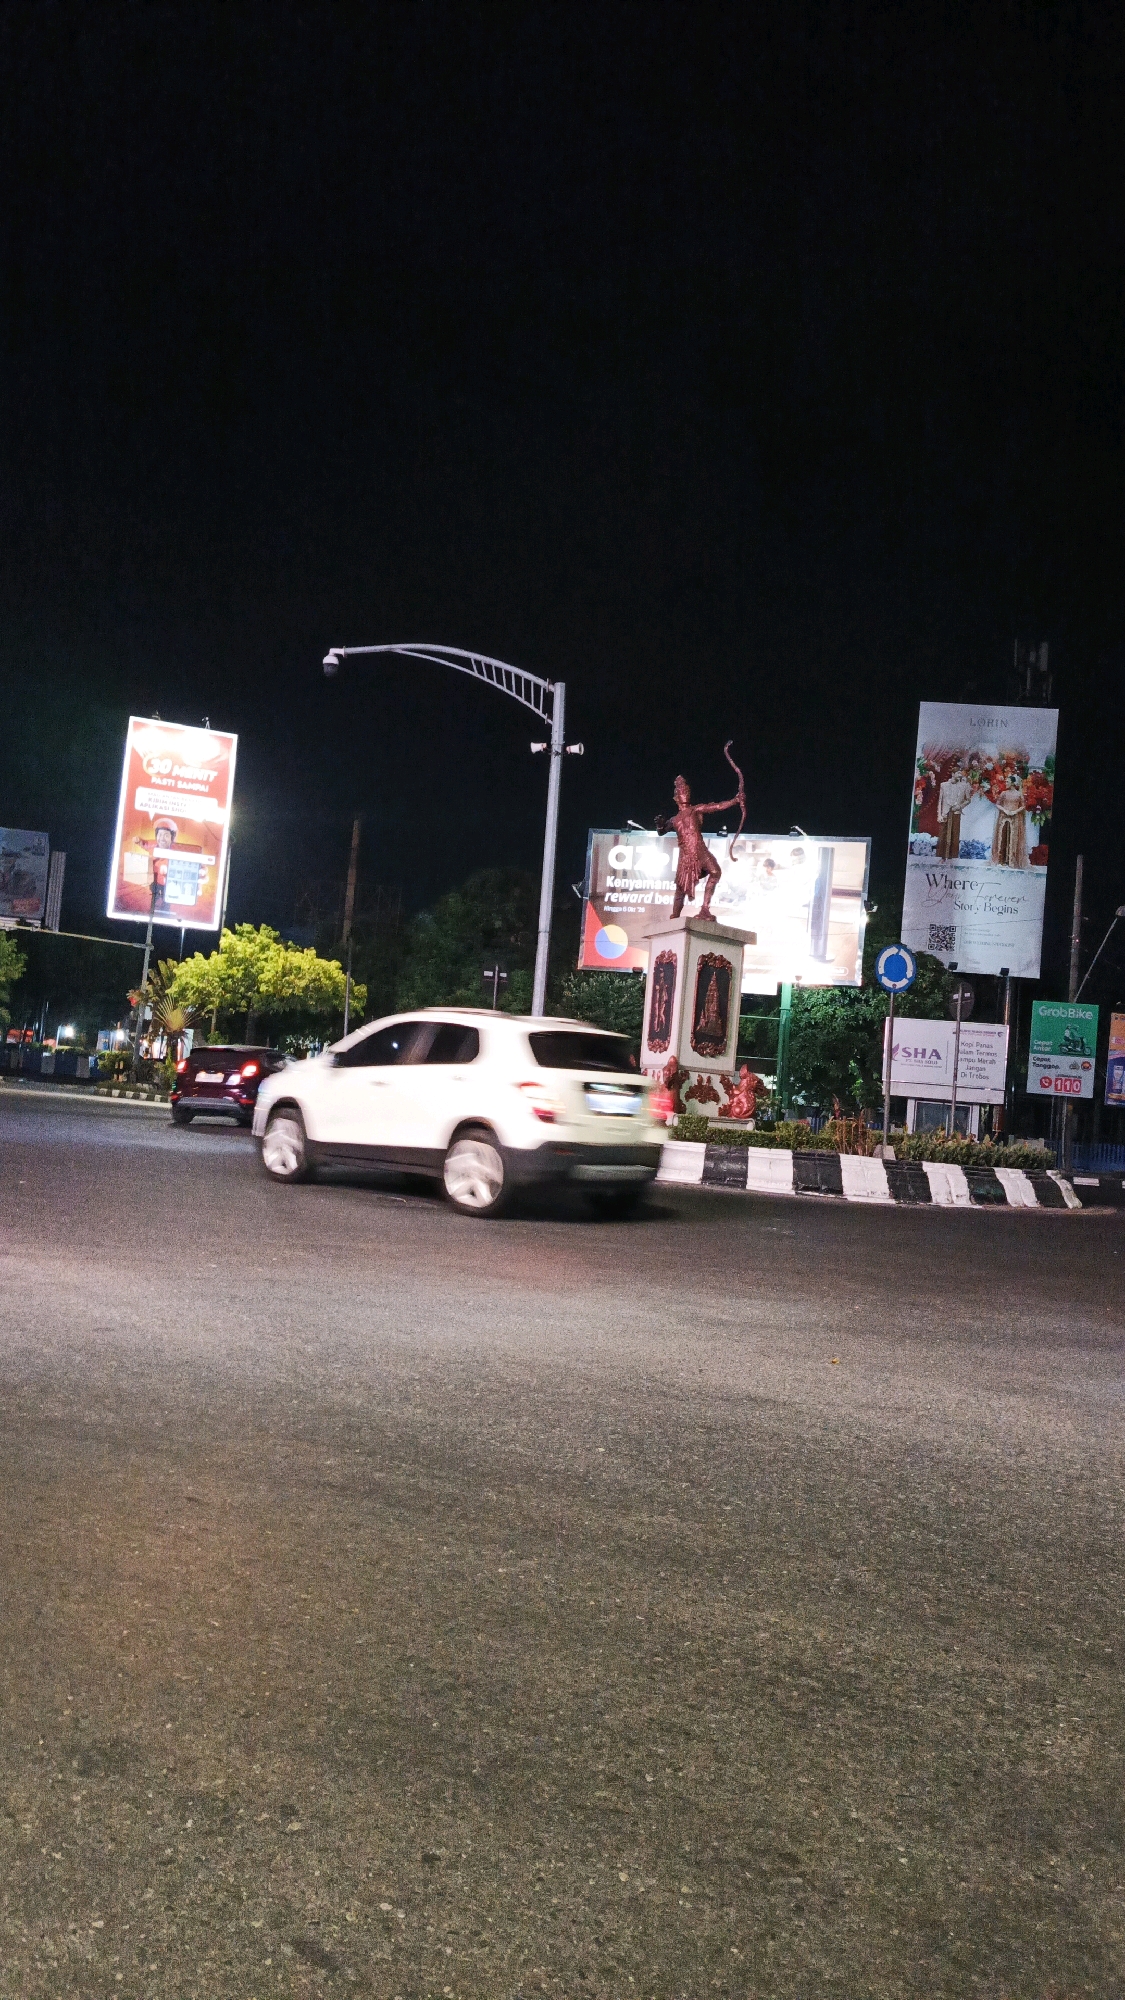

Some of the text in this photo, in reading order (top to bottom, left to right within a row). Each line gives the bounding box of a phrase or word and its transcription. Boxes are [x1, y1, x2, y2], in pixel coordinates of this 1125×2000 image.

[969, 718, 1008, 728] LORIN
[148, 758, 173, 774] 30
[150, 776, 209, 792] PASTI SAMPAI
[606, 875, 677, 891] Kenyamana
[925, 873, 979, 891] Where
[604, 891, 654, 904] reward
[953, 900, 1019, 916] Story Begins
[1039, 1006, 1094, 1019] GrabBike
[960, 1041, 994, 1049] Kopi Panas
[901, 1047, 942, 1060] SHA
[976, 1049, 998, 1057] Termos
[977, 1057, 997, 1065] Merah
[965, 1064, 986, 1072] Jangan
[1055, 1079, 1081, 1093] 110
